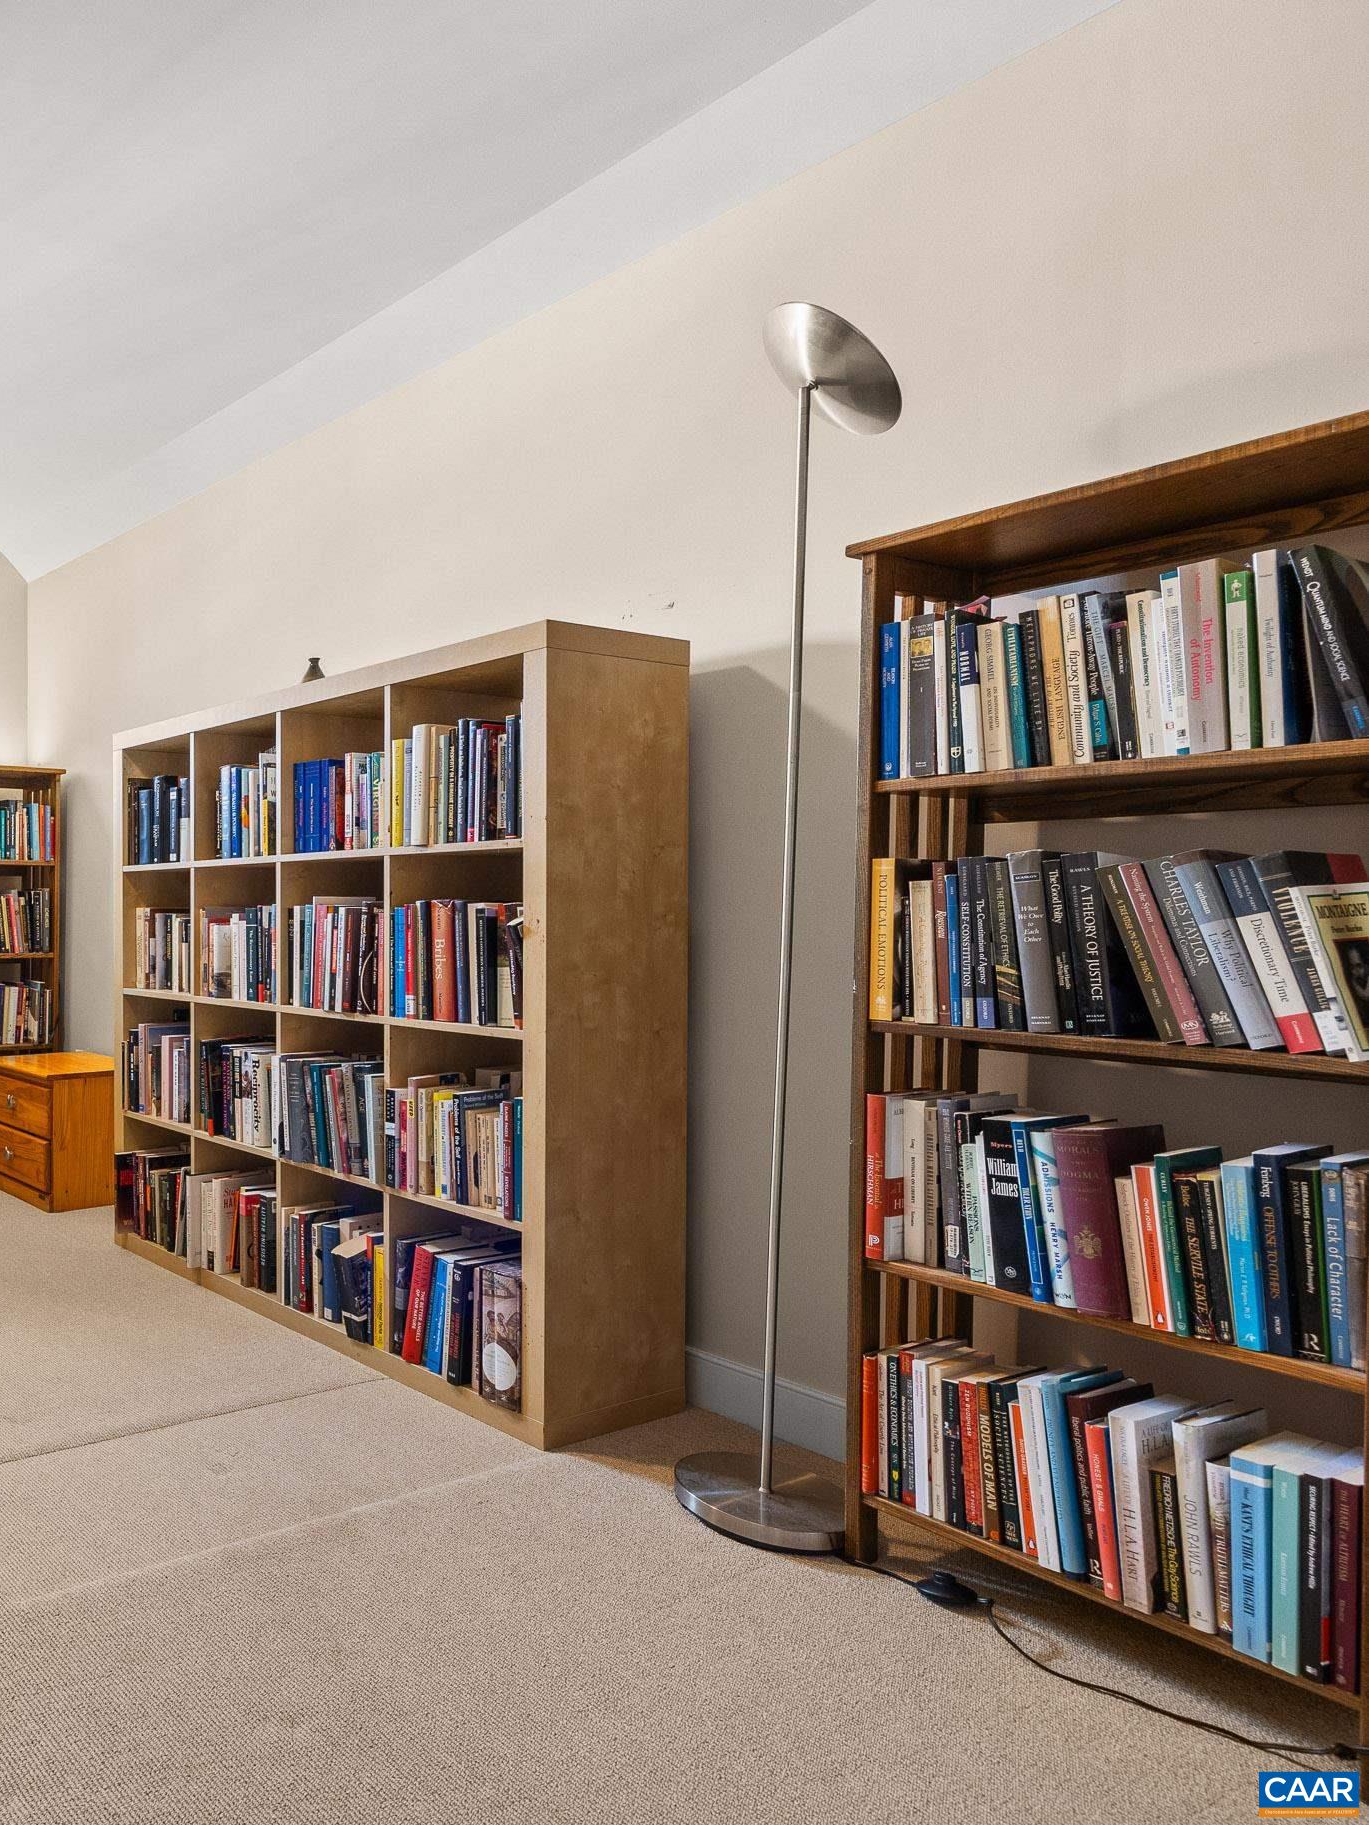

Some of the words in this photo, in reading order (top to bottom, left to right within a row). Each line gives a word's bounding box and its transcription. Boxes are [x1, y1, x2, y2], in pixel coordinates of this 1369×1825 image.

[1301, 556, 1314, 577] WENDT
[1091, 610, 1099, 624] THE
[1203, 619, 1213, 637] The
[1263, 618, 1274, 640] Twilight
[1027, 617, 1037, 670] METAPHORS
[1094, 628, 1103, 644] GIFT
[1191, 639, 1199, 648] of
[960, 651, 970, 681] NORMAL
[986, 656, 994, 681] SIMMEL
[1007, 628, 1018, 686] UTILITARIANISM
[1069, 651, 1081, 682] Society
[1141, 658, 1150, 686] Democracy
[1204, 639, 1214, 684] Invention
[1238, 652, 1246, 688] economics
[1265, 651, 1275, 677] Authority
[1031, 676, 1038, 686] WE
[1052, 658, 1060, 702] LANGUAGE
[1089, 672, 1098, 695] People
[1100, 654, 1109, 683] MARCEL
[1107, 686, 1115, 711] MAUSS
[1191, 653, 1202, 701] Autonomy
[1032, 693, 1040, 714] LIVE
[1072, 684, 1081, 702] and
[1035, 721, 1042, 730] BY
[1055, 706, 1065, 740] ENGLISH
[1074, 704, 1085, 757] Community
[1049, 870, 1058, 884] The
[1129, 868, 1142, 892] Naming
[878, 874, 887, 929] POLITICAL
[976, 899, 985, 912] The
[1051, 885, 1059, 903] Good
[1139, 893, 1147, 902] the
[1194, 881, 1211, 914] Weithman
[997, 901, 1006, 933] RETRIEVAL
[1052, 904, 1062, 923] Polity
[1082, 895, 1096, 939] THEORY
[1141, 903, 1154, 923] System
[1160, 861, 1192, 916] CHARLES
[1183, 918, 1209, 966] TAYLOR
[1162, 898, 1179, 927] Dilemmas
[1272, 887, 1310, 953] VIOLENCE
[1315, 902, 1368, 920] MONTAIGNE
[961, 902, 970, 987] SELF-CONSTITUTION
[978, 914, 986, 952] Constitution
[1000, 934, 1007, 944] OF
[1118, 905, 1133, 929] TREATISE
[1126, 930, 1136, 939] ON
[1131, 941, 1146, 958] SOCIAL
[1139, 961, 1154, 983] THEORY
[1174, 929, 1183, 939] and
[435, 938, 446, 979] Bribes
[877, 934, 886, 990] EMOTIONS
[1000, 945, 1009, 967] ETHICS
[1086, 942, 1099, 956] OF
[1177, 939, 1197, 976] Connections
[1208, 932, 1235, 981] Liberalism?
[1221, 929, 1236, 950] Why
[1229, 953, 1253, 988] Political
[1250, 918, 1277, 976] Discretionary
[1271, 979, 1289, 1003] Time
[978, 962, 987, 985] Agency
[1087, 959, 1103, 1001] JUSTICE
[252, 1059, 260, 1132] Reciprocity
[987, 1158, 1018, 1177] William
[1260, 1167, 1272, 1197] Feinberg
[874, 1174, 882, 1204] Essential
[991, 1178, 1018, 1197] James
[1041, 1162, 1054, 1213] ADMISSIONS
[1301, 1182, 1310, 1219] LIBERALISMS
[1186, 1217, 1196, 1233] THE
[1264, 1207, 1278, 1248] OFFENSE
[1326, 1217, 1340, 1244] Lack
[1050, 1222, 1058, 1249] HENRY
[1055, 1252, 1063, 1280] MARSH
[1188, 1235, 1204, 1278] SERVILE
[1267, 1251, 1278, 1262] TO
[1306, 1244, 1314, 1265] Political
[1329, 1247, 1342, 1260] of
[1269, 1264, 1280, 1299] OTHERS
[1303, 1266, 1315, 1294] Philosophy
[1329, 1262, 1344, 1320] Character
[1194, 1282, 1207, 1313] STATE
[979, 1414, 992, 1461] MODELS
[1072, 1417, 1082, 1437] liberal
[1074, 1438, 1085, 1461] politics
[984, 1463, 993, 1478] OF
[1078, 1462, 1087, 1476] and
[986, 1480, 997, 1511] MAN
[1078, 1477, 1088, 1498] public
[1083, 1499, 1091, 1515] faith
[1183, 1495, 1197, 1531] JOHN
[1241, 1502, 1253, 1533] KANT'S
[1188, 1534, 1201, 1577] RAWLS
[1216, 1534, 1227, 1565] TRUTH
[1242, 1535, 1253, 1572] ETHICAL
[1218, 1570, 1229, 1612] MATTERS
[1244, 1575, 1255, 1617] THOUGHT
